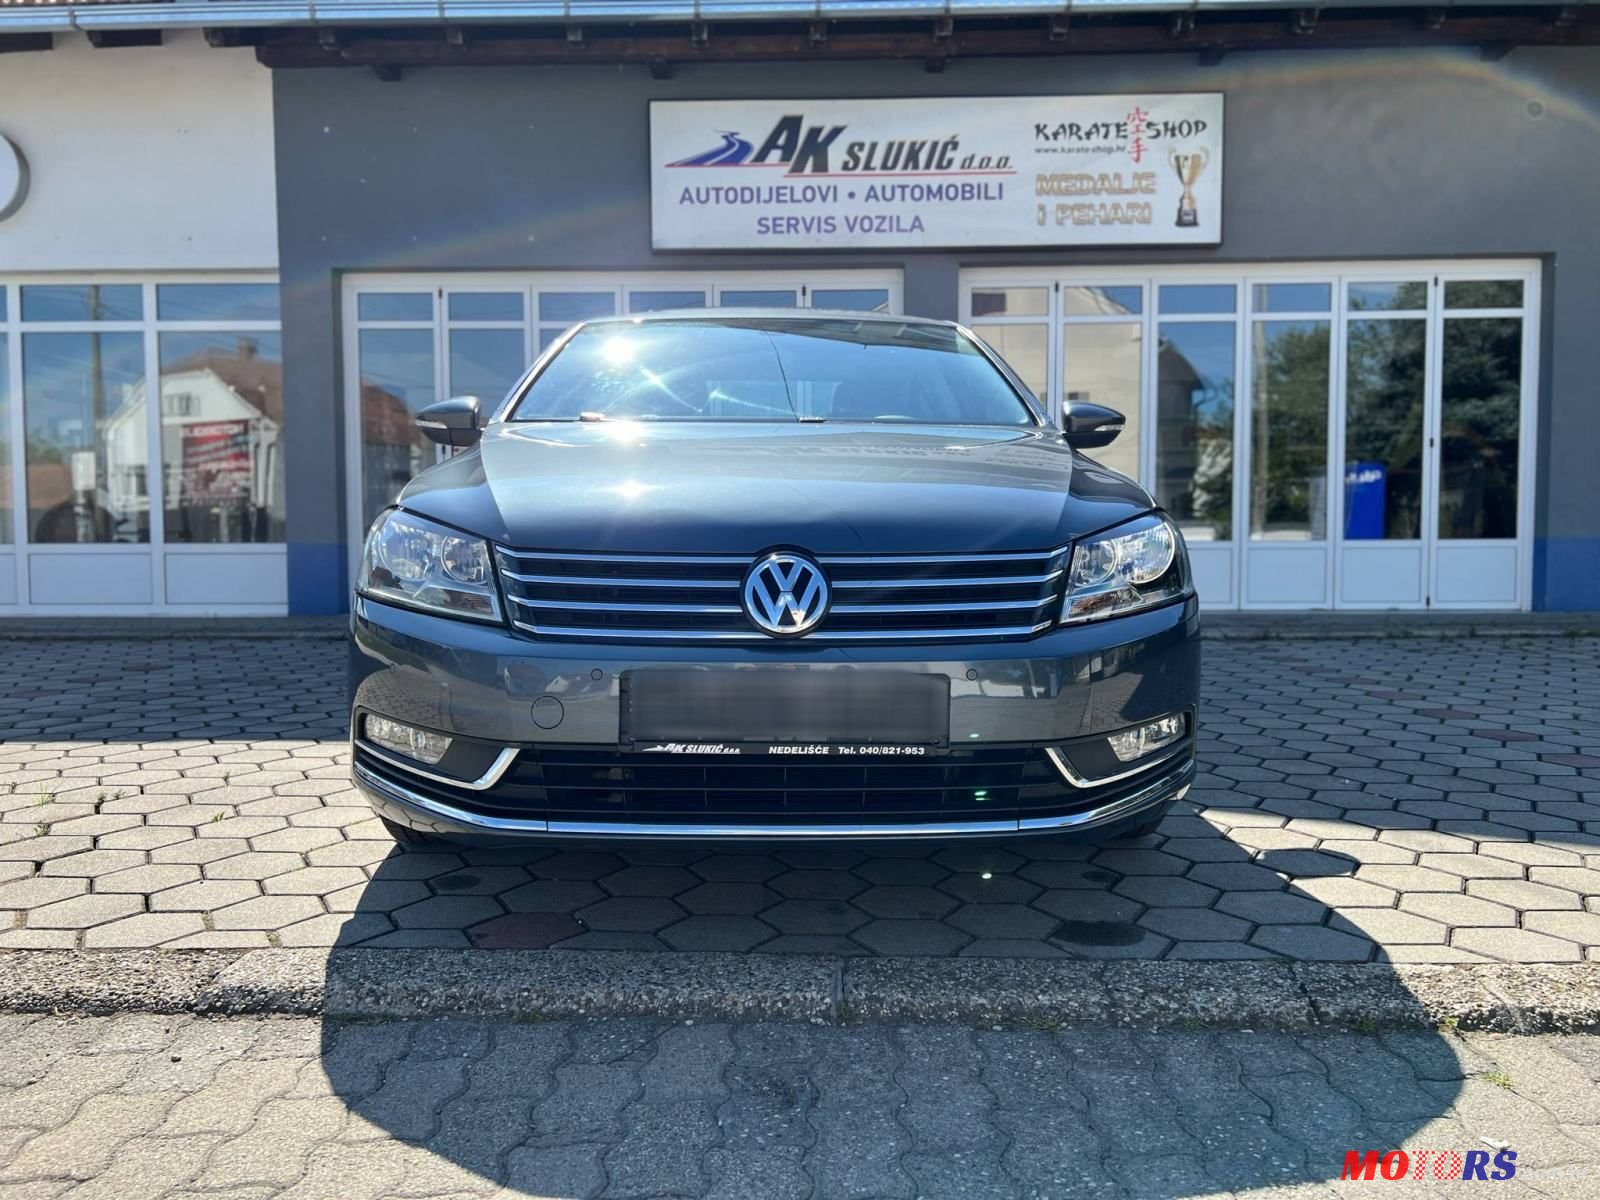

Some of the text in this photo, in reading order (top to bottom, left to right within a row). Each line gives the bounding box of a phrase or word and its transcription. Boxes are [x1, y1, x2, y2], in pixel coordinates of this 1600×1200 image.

[1034, 120, 1208, 141] KARATE SHOP
[1127, 106, 1148, 163] 空手
[752, 114, 848, 173] AK
[841, 134, 960, 172] SLUKIĆ
[679, 183, 1004, 205] AUTODIJELOVI AUTOMOBILI
[1035, 172, 1157, 196] MEDALJE
[757, 215, 925, 234] SERVIS VOZILA
[1056, 202, 1153, 225] PEHARI
[685, 743, 724, 753] SLUKIĆ
[769, 744, 925, 755] NEDELIŠĆE Tel. 040/821-953
